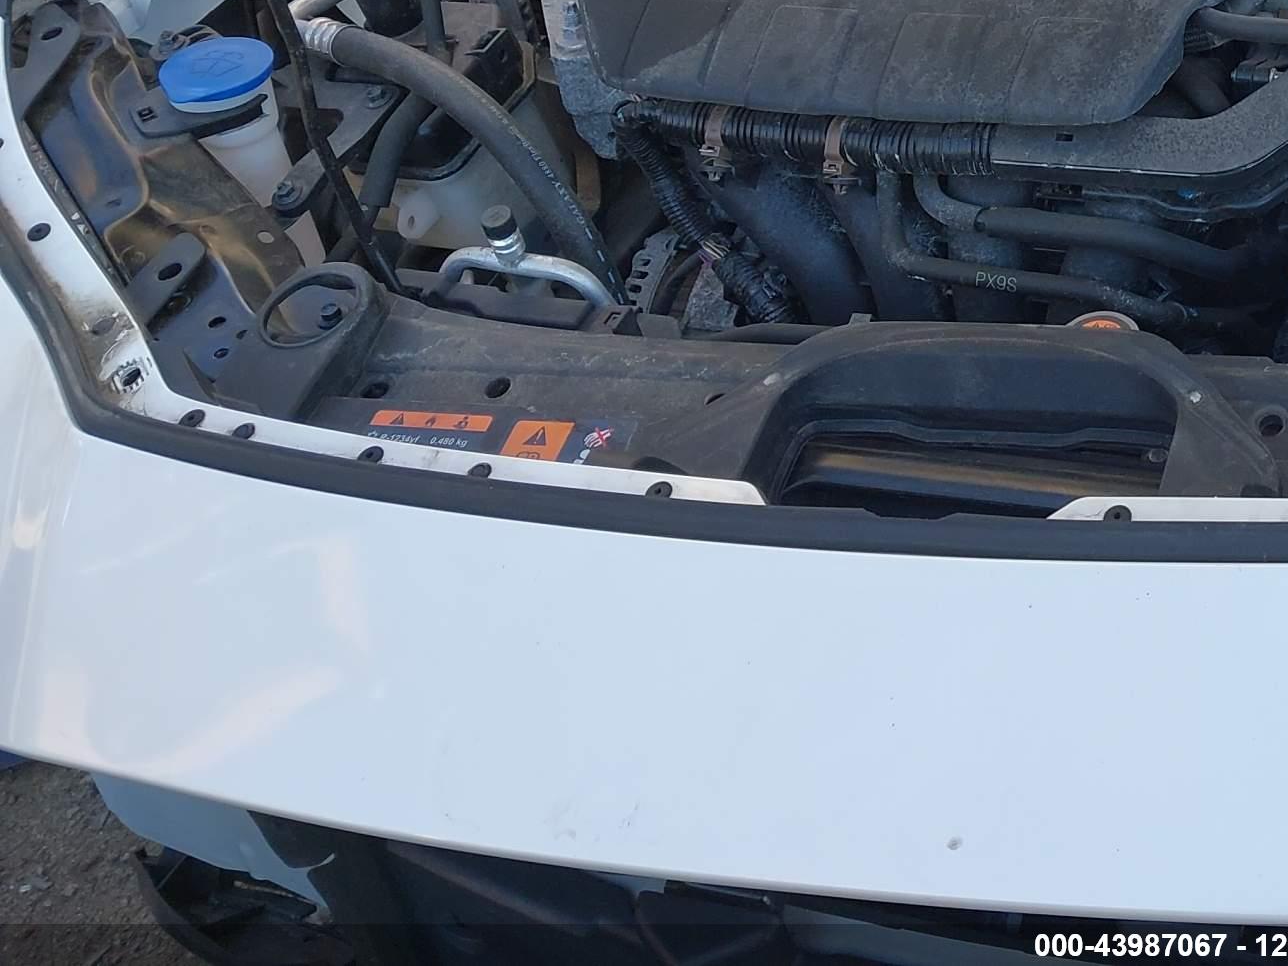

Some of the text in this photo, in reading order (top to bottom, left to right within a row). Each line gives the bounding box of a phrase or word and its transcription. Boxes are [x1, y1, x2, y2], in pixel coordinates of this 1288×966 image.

[975, 271, 1017, 293] PX9S
[429, 436, 455, 446] 0.480
[455, 437, 469, 448] kg
